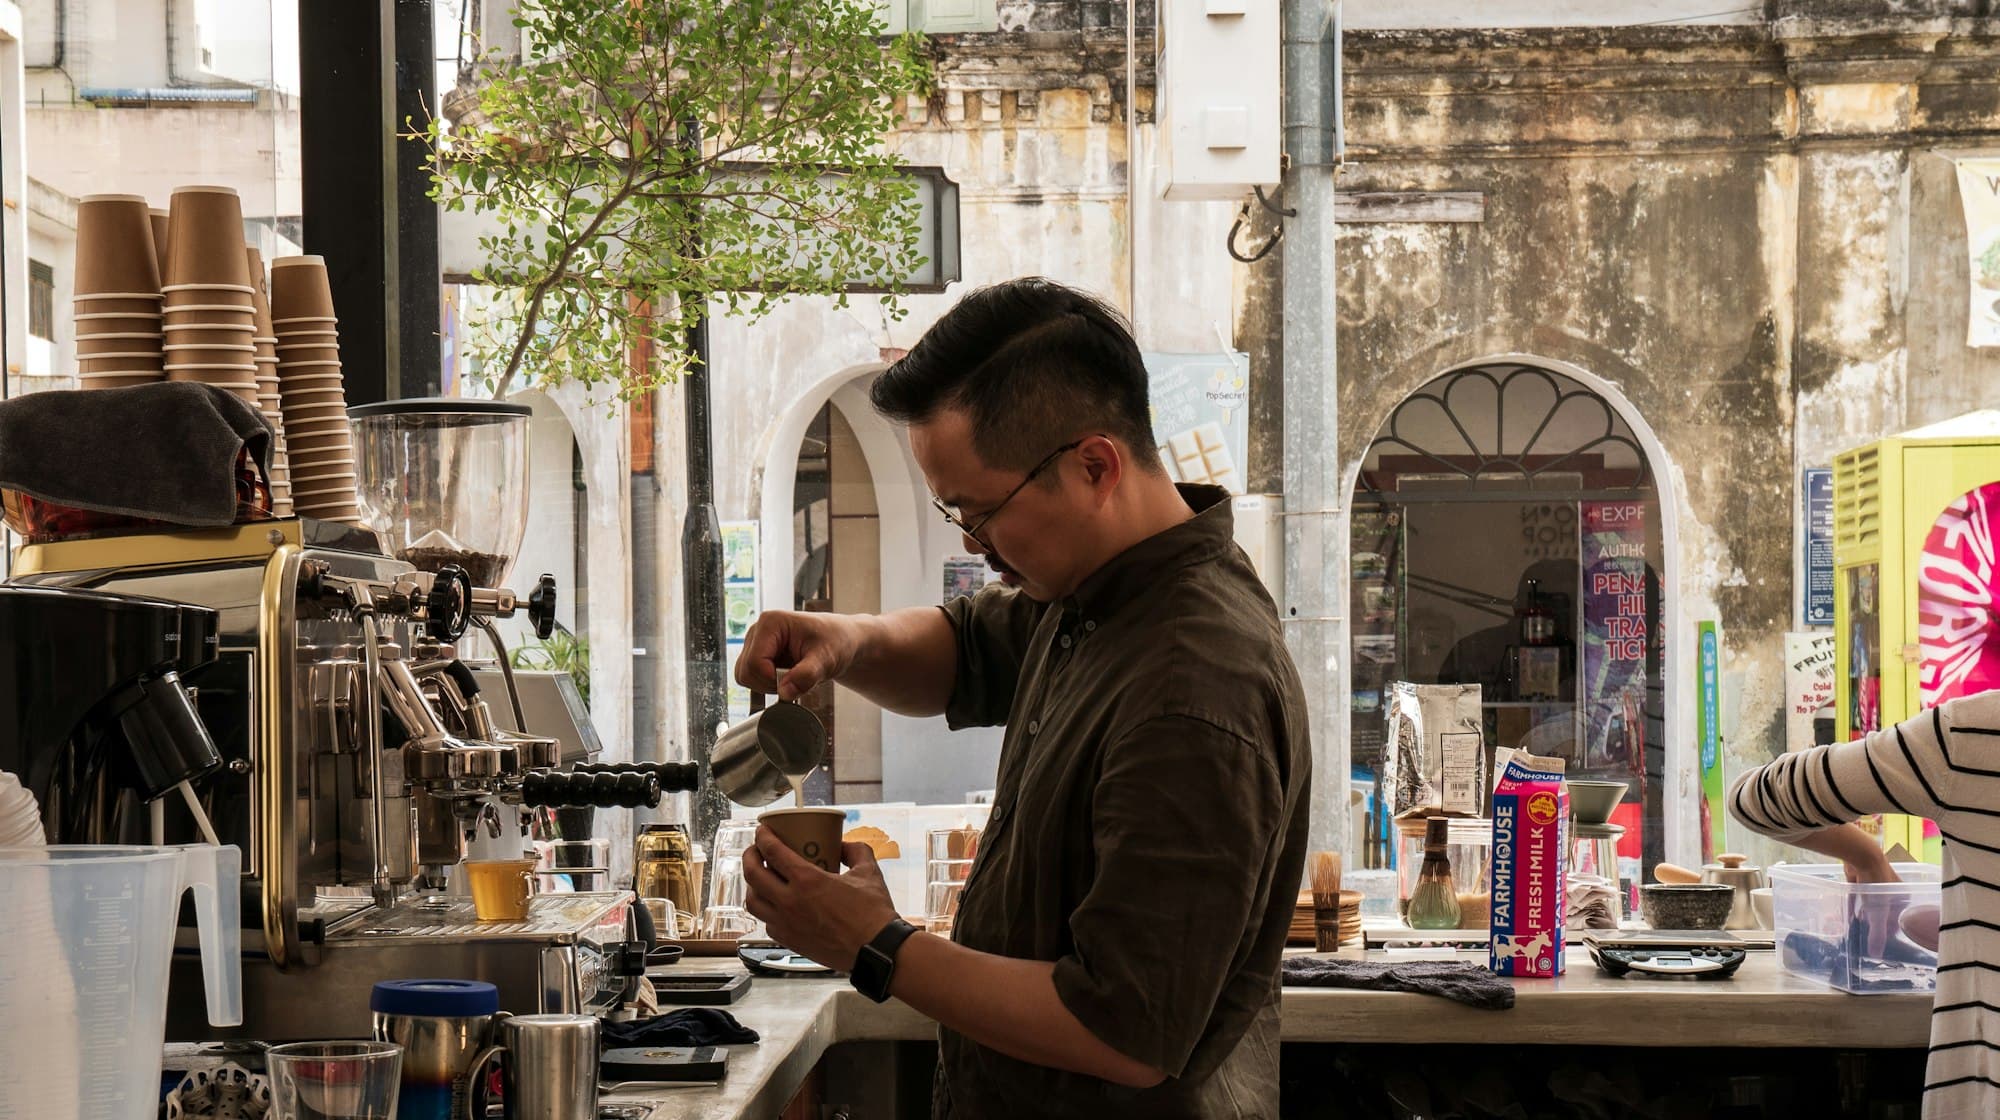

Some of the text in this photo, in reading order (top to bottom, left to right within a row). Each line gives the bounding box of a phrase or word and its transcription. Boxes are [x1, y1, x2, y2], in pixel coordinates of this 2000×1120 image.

[1508, 766, 1561, 780] FARMHOUSE
[1494, 806, 1512, 928] FARMHOUSE
[1530, 827, 1544, 870] MILK
[1528, 872, 1542, 929] FRESH
